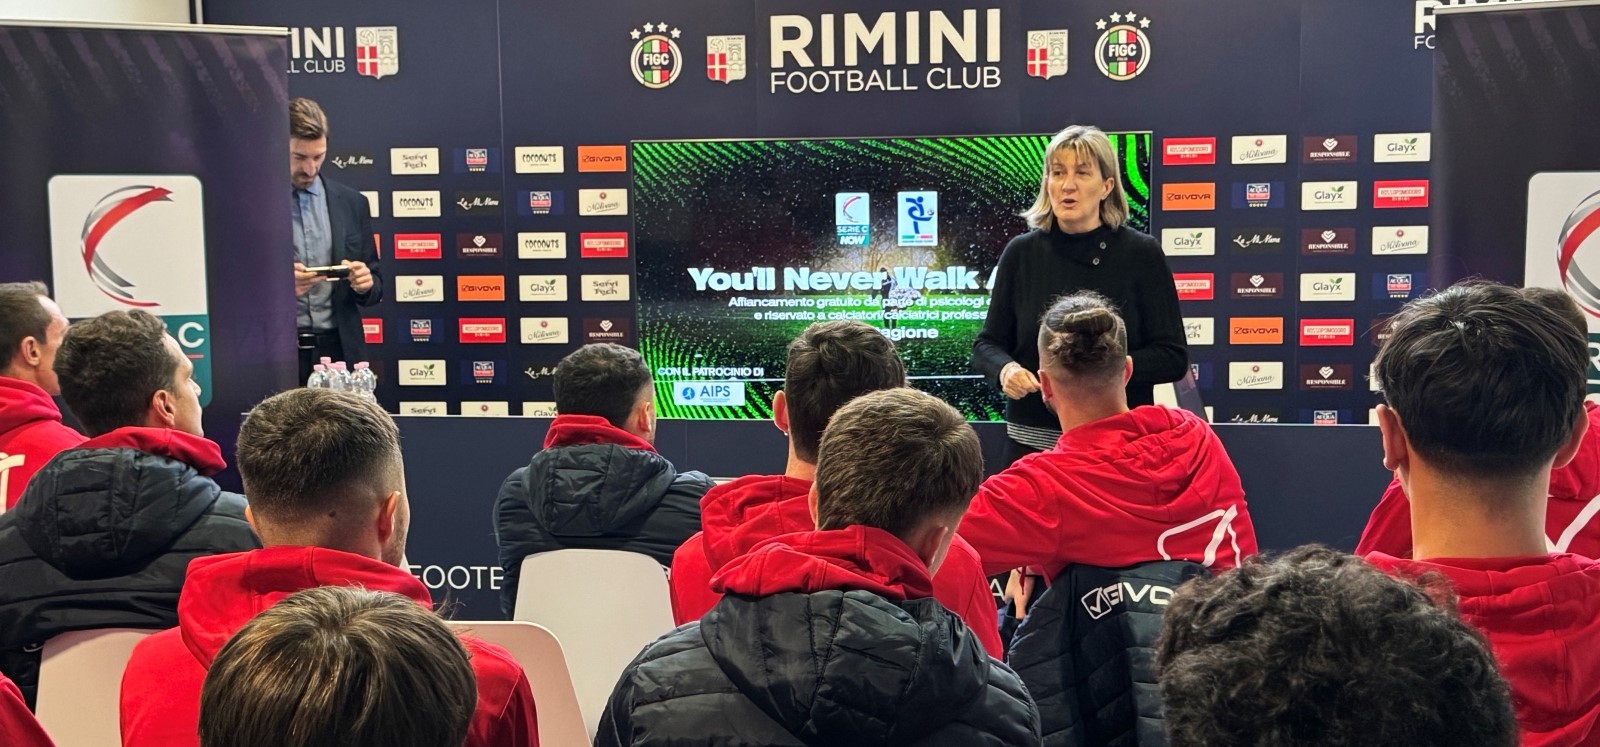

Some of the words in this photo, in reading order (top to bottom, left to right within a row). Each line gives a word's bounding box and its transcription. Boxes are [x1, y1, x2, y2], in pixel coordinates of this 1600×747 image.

[291, 27, 345, 58] INI
[770, 8, 1001, 68] RIMINI
[1108, 44, 1137, 57] FIGC
[643, 53, 669, 66] FIGC
[304, 59, 346, 73] CLUB
[771, 69, 918, 93] FOOTBALL
[926, 66, 1001, 90] CLUB
[1387, 142, 1416, 154] Glayx
[1314, 190, 1343, 201] Glayx
[840, 236, 866, 245] NOW
[1174, 236, 1201, 248] Glayx
[687, 266, 776, 291] You'll
[784, 266, 887, 291] Never
[893, 265, 980, 290] Walk
[530, 283, 556, 294] Glayx
[1313, 282, 1341, 293] Glayx
[728, 297, 815, 308] Affiancamento
[816, 296, 862, 310] gratuito
[864, 295, 880, 307] da
[915, 296, 927, 307] di
[930, 296, 984, 308] psicologi
[754, 311, 763, 320] e
[764, 310, 815, 321] riservato
[817, 311, 826, 320] a
[941, 310, 987, 322] profess
[409, 367, 434, 378] Glayx
[657, 366, 681, 377] CON
[682, 366, 691, 377] IL
[692, 366, 752, 377] PATROCINIO
[753, 366, 764, 377] DI
[700, 385, 731, 397] AIPS
[1106, 582, 1174, 605] GIVO
